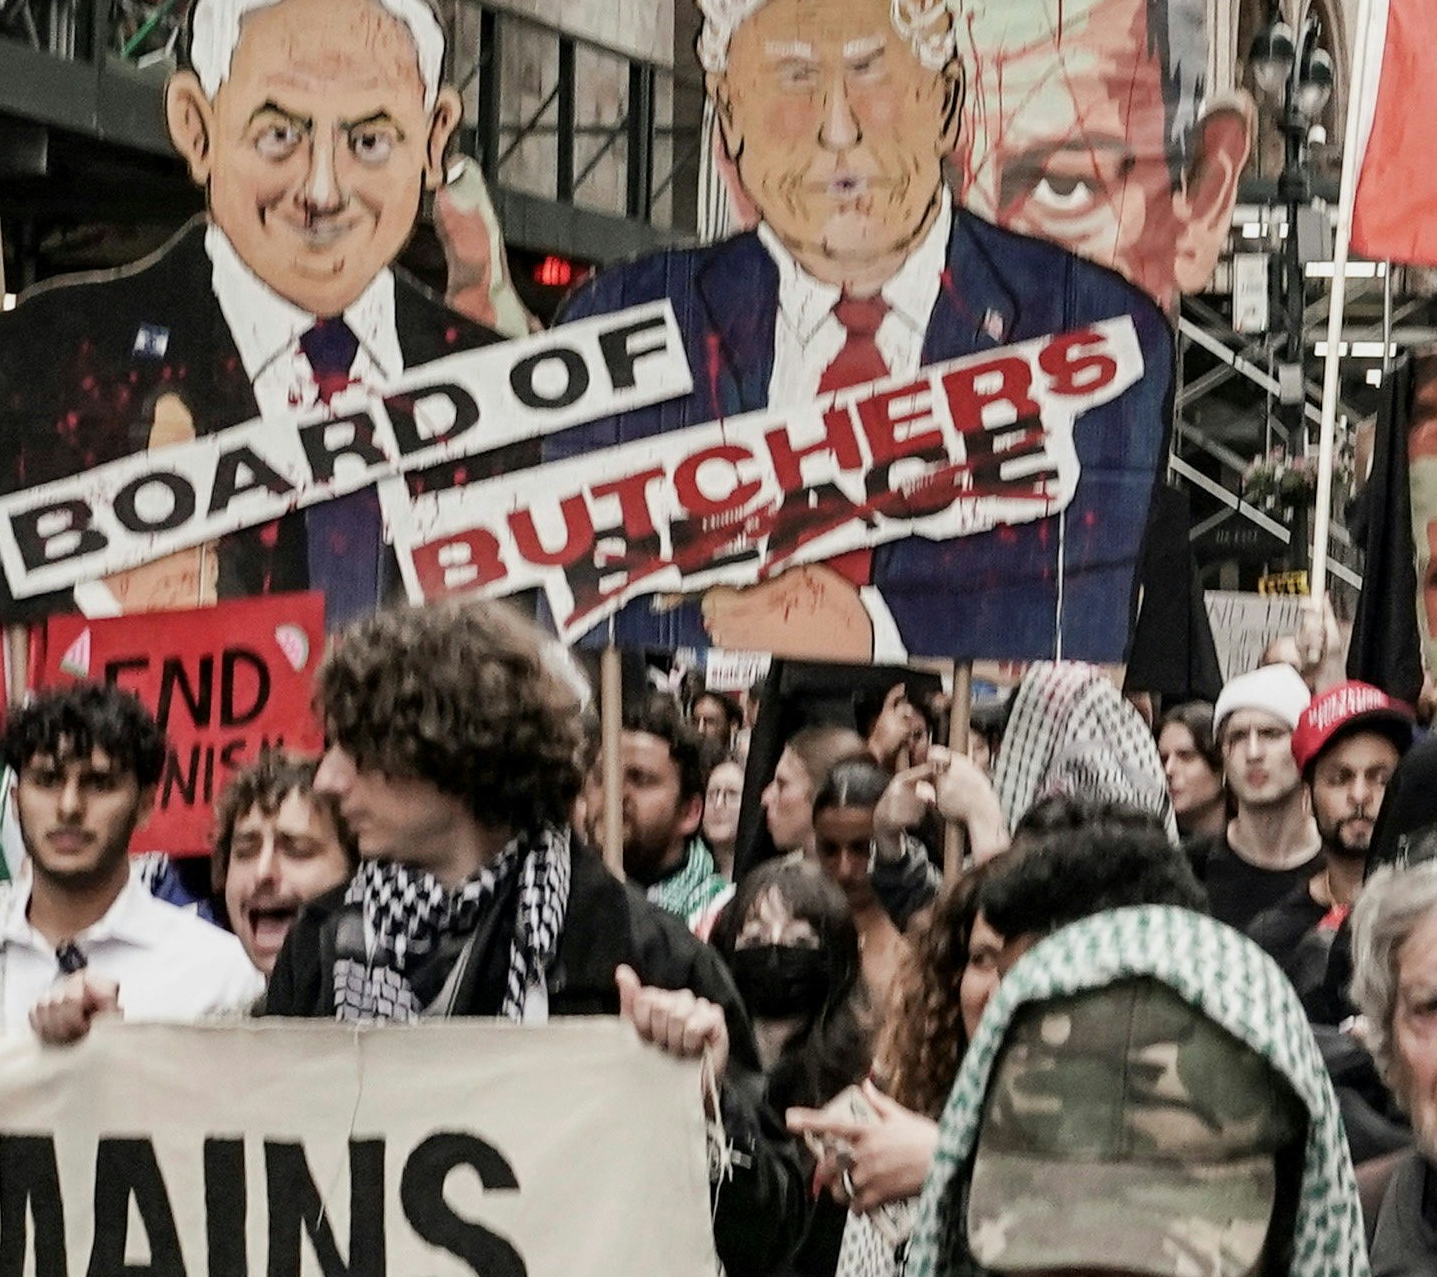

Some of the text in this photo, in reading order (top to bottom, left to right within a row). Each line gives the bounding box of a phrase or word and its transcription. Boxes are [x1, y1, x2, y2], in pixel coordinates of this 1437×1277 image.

[9, 315, 671, 573] BOARD OF
[412, 328, 1120, 602] BUTCHERS
[104, 648, 271, 733] ND
